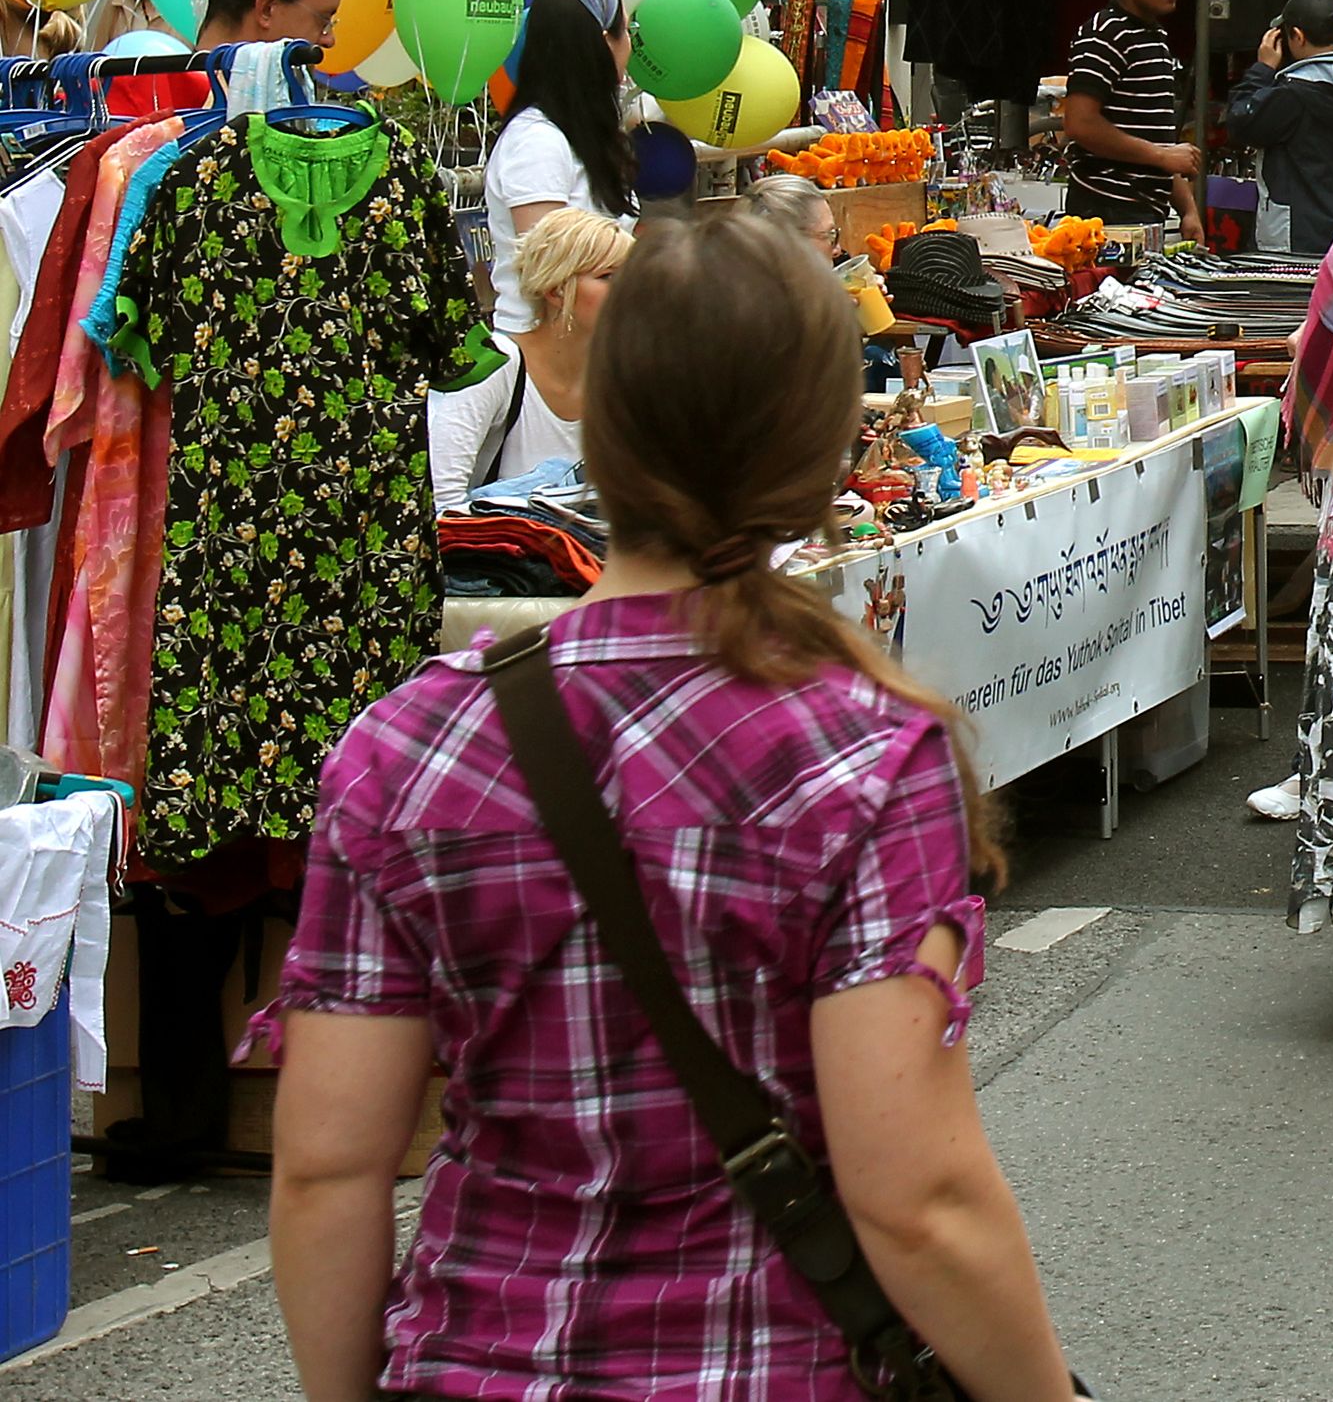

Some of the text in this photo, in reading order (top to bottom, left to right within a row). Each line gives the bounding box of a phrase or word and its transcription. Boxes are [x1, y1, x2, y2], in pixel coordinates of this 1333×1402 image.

[1010, 663, 1033, 698] für
[1035, 654, 1062, 688] das
[1066, 631, 1103, 676] Yuthok
[1105, 612, 1133, 655] Spital
[1135, 607, 1146, 636] in
[1149, 591, 1187, 629] Tibet
